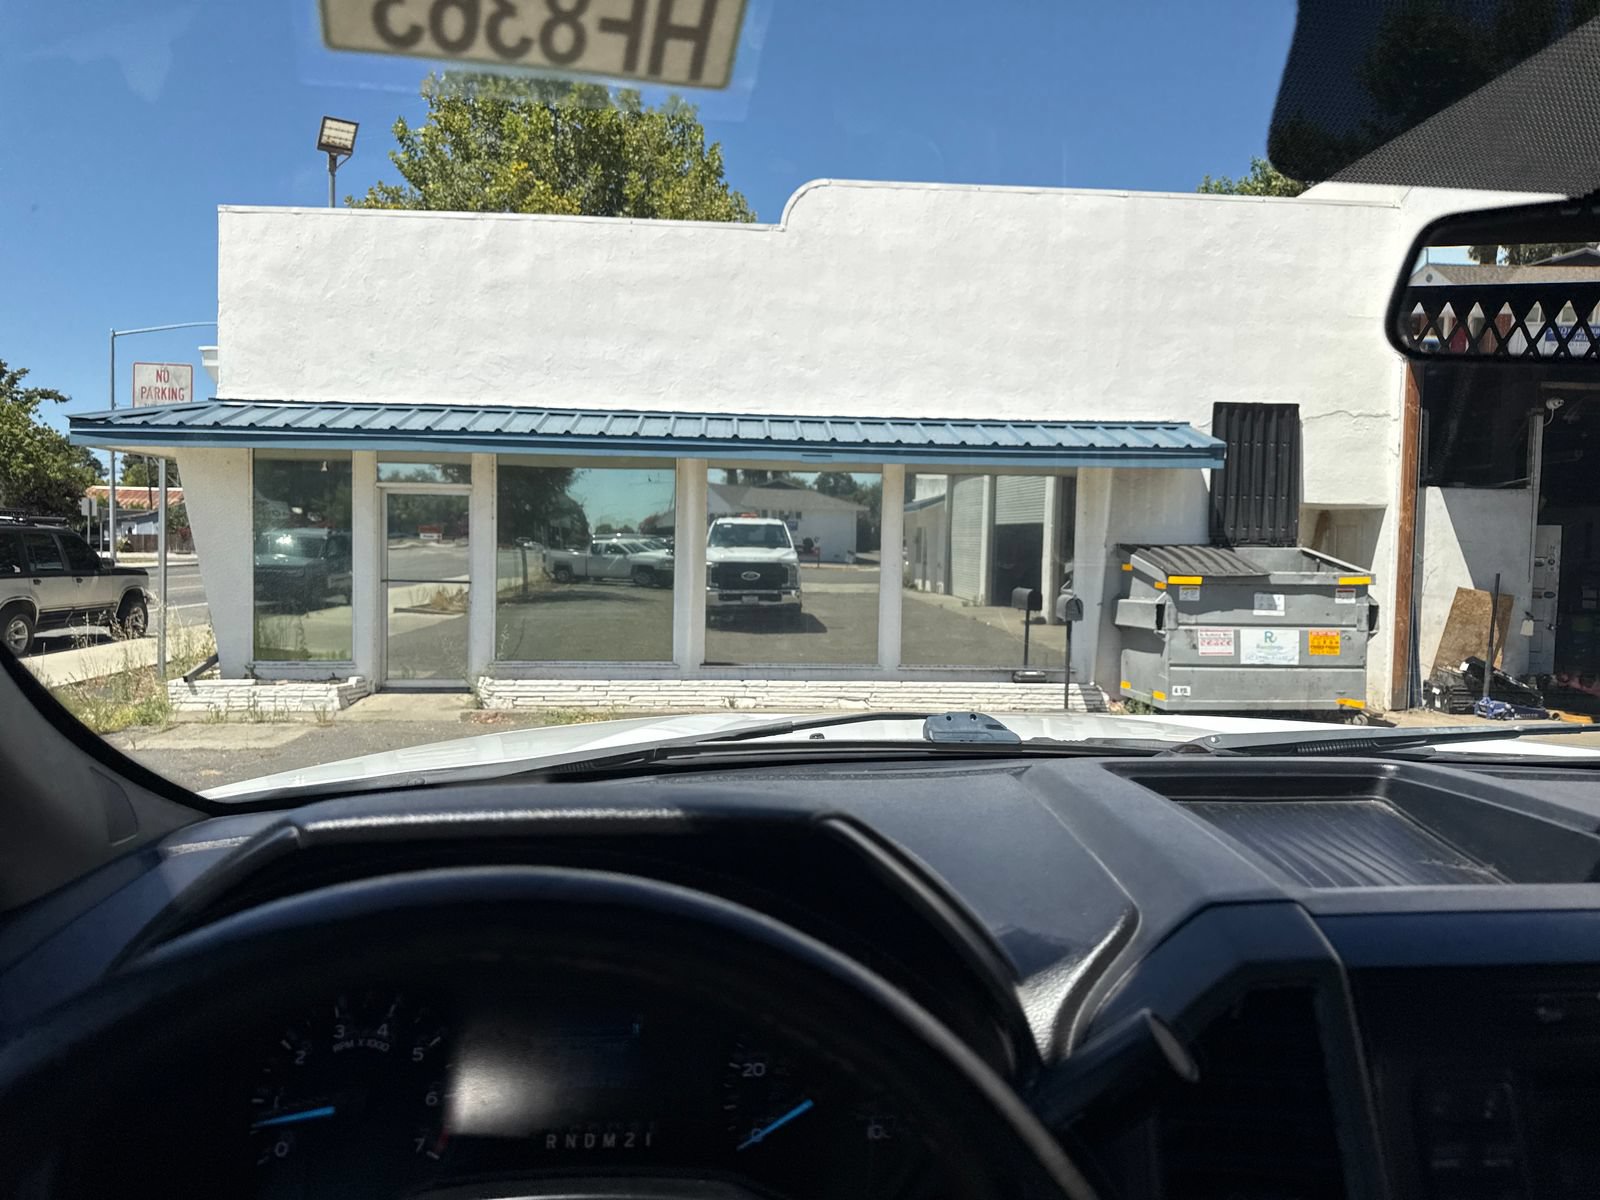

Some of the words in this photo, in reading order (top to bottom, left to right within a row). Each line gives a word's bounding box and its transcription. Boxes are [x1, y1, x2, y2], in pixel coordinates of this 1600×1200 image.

[155, 368, 170, 383] NO
[140, 386, 185, 401] PARKING
[332, 1024, 345, 1039] 3
[376, 1023, 389, 1037] 4
[332, 1039, 355, 1054] RPM
[411, 1046, 424, 1062] 5
[294, 1049, 307, 1066] 2
[741, 1062, 768, 1078] 20
[425, 1091, 438, 1107] 6
[414, 1137, 426, 1154] 7
[545, 1134, 557, 1149] R
[565, 1134, 577, 1148] N
[584, 1133, 596, 1149] D
[602, 1132, 616, 1148] M
[624, 1132, 636, 1148] 2
[274, 1141, 289, 1158] 0
